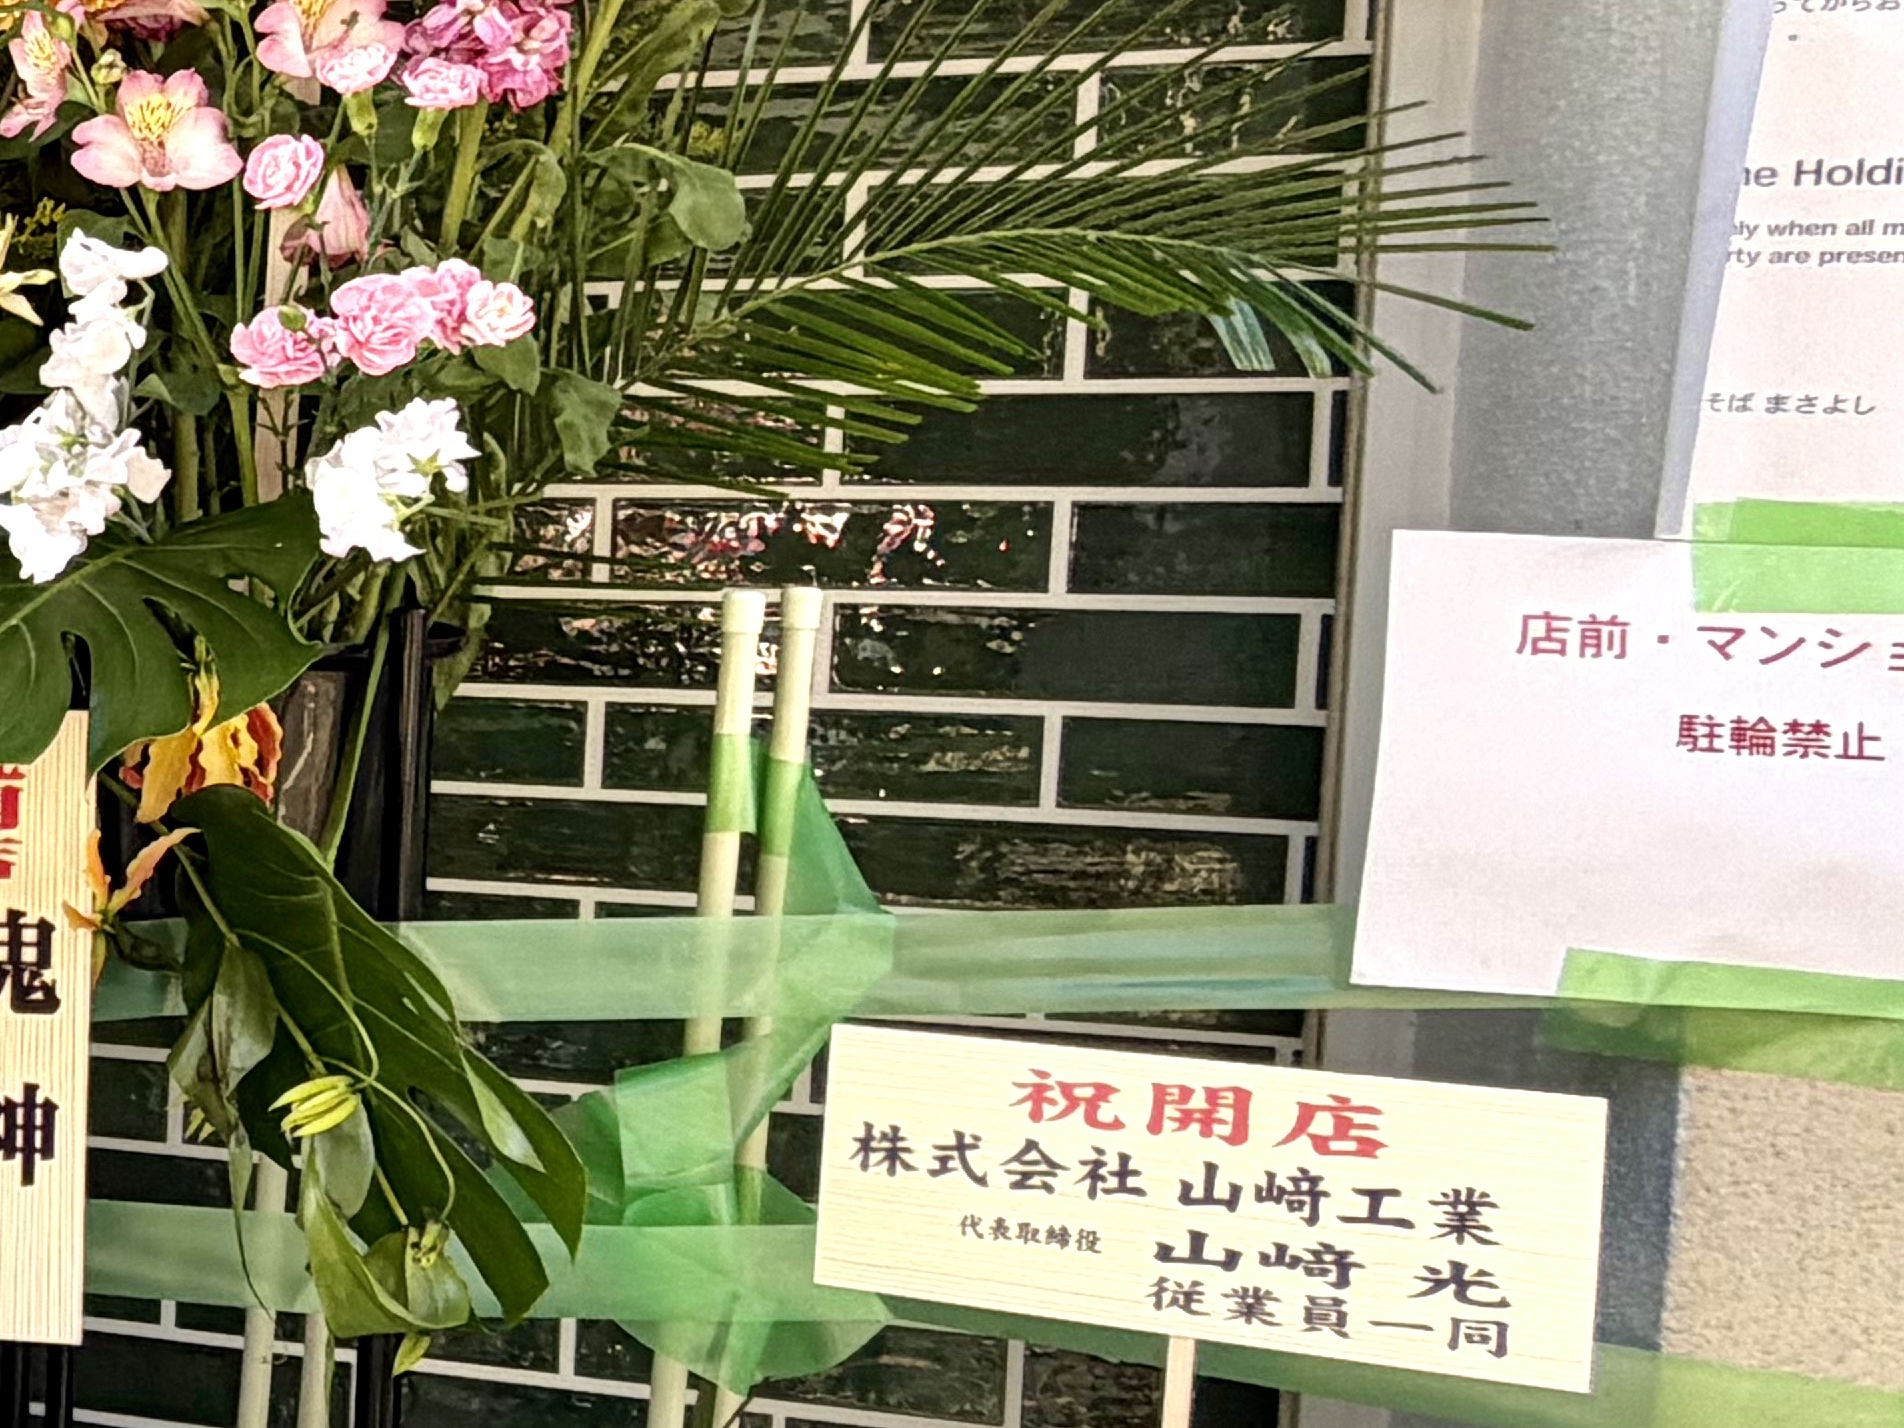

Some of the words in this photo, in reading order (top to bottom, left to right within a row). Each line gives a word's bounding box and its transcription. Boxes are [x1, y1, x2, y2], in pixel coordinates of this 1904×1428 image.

[1766, 219, 1838, 237] when
[1844, 218, 1876, 237] all
[1767, 249, 1811, 265] are
[1763, 392, 1877, 416] まさよし
[1673, 714, 1886, 762] 駐輪禁止
[1008, 1068, 1390, 1160] 祝開店
[958, 1213, 1103, 1255] 代表取締役
[1147, 1275, 1510, 1359] 従業員一同
